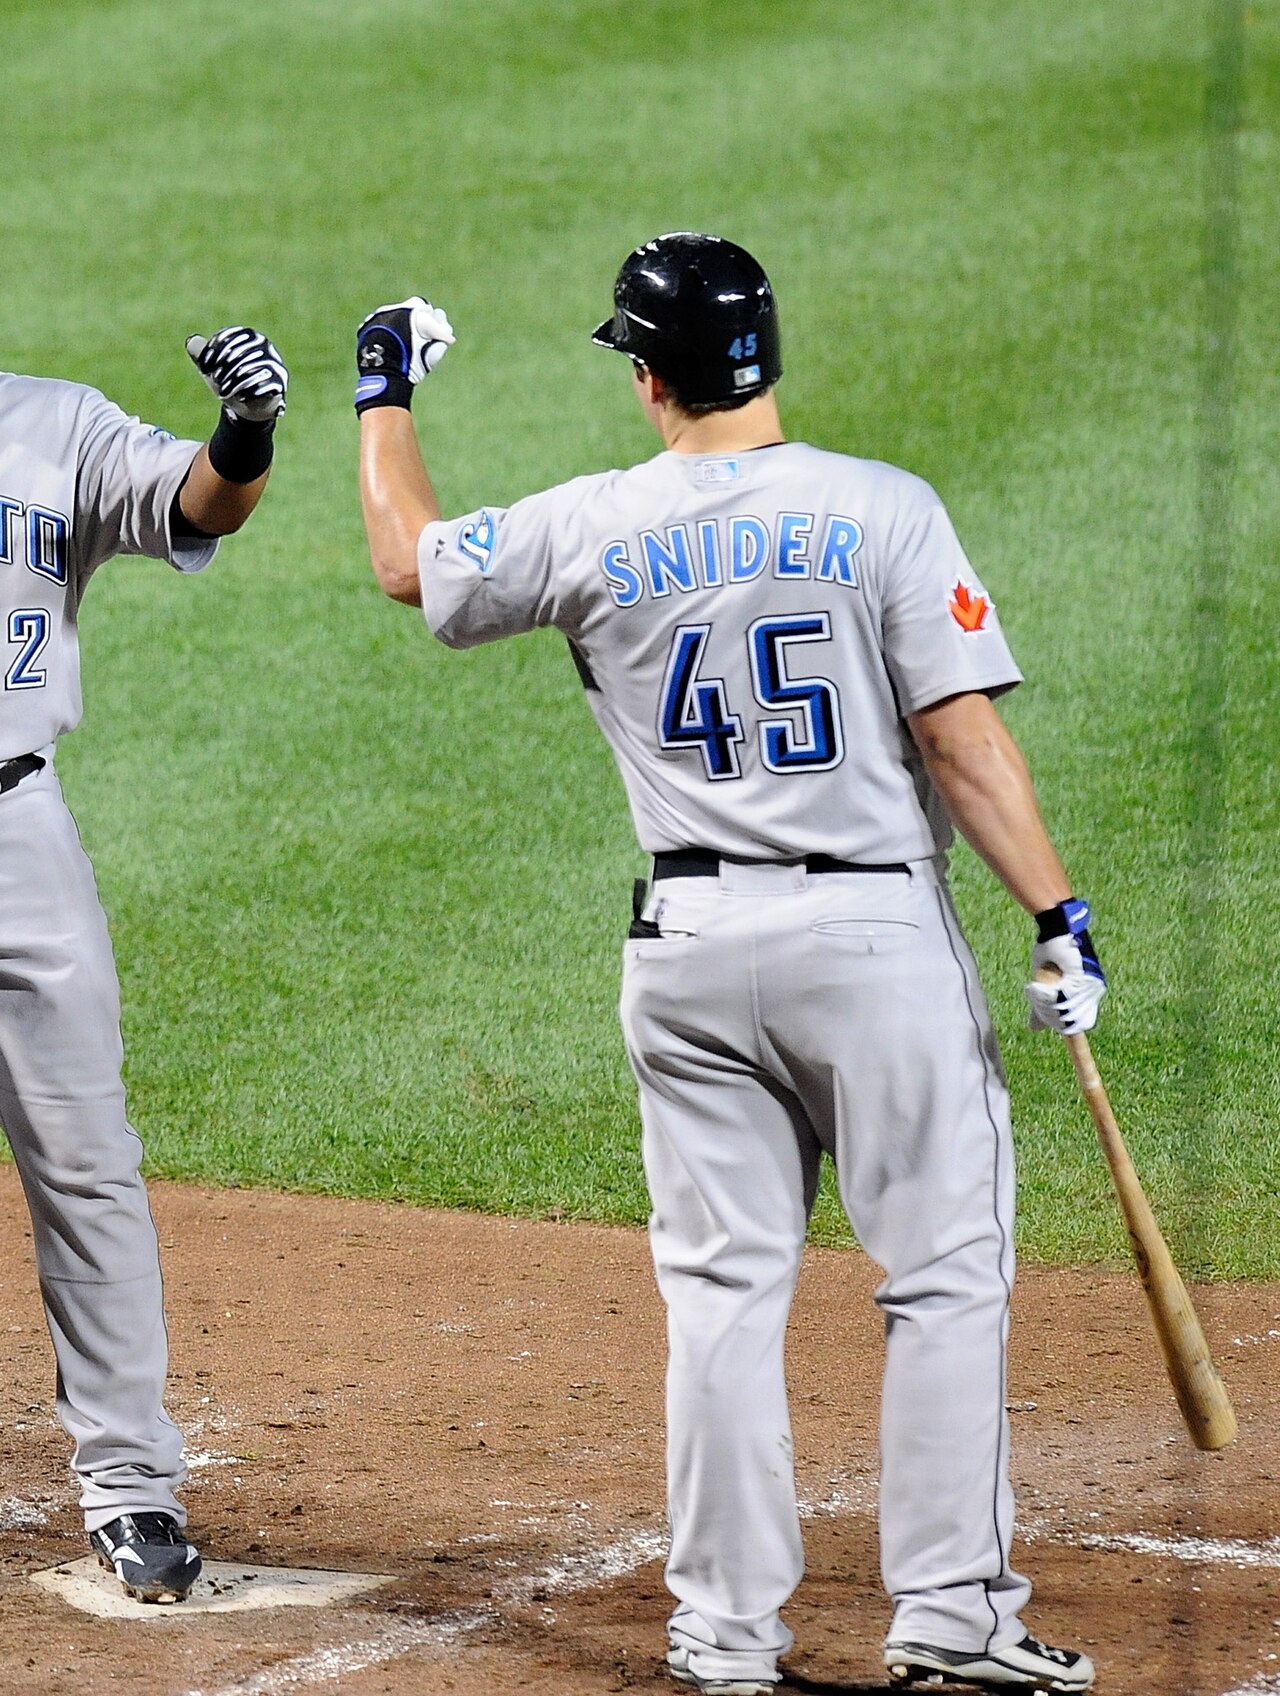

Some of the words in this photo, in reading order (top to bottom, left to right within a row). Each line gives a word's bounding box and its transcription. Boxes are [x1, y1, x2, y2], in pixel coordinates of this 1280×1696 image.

[728, 332, 757, 360] 45
[602, 511, 864, 609] SNIDER
[656, 610, 846, 782] 45
